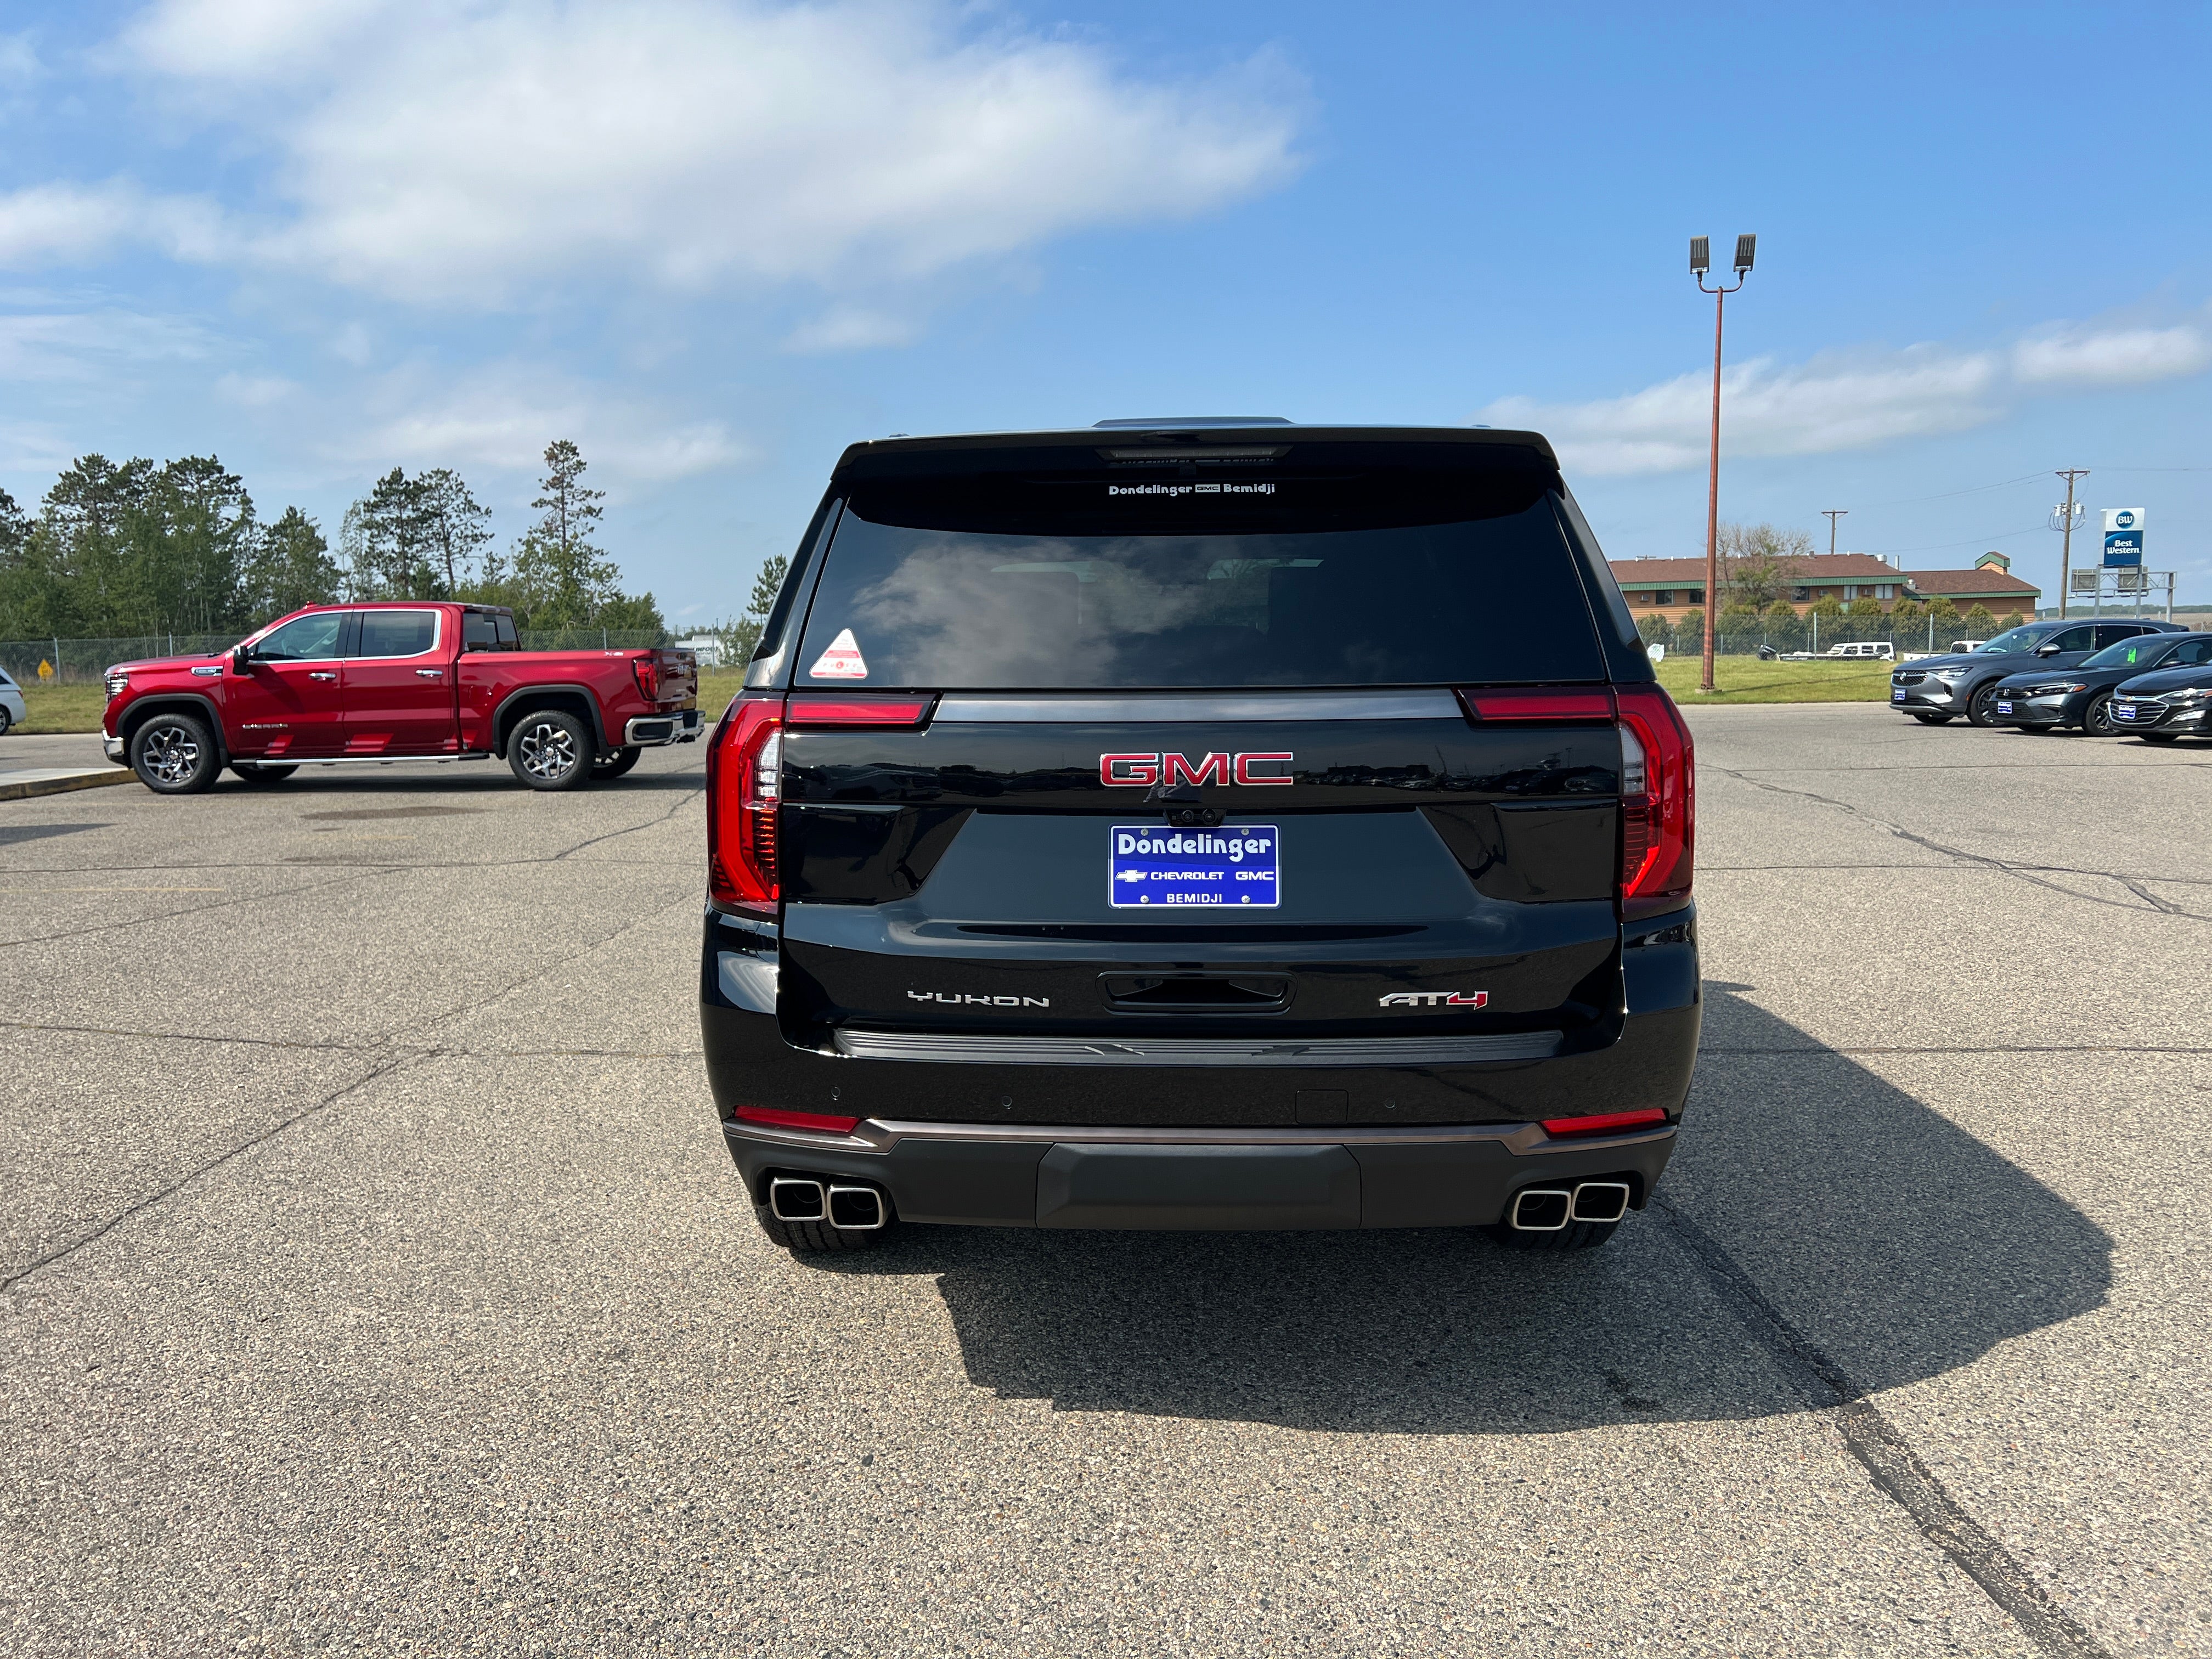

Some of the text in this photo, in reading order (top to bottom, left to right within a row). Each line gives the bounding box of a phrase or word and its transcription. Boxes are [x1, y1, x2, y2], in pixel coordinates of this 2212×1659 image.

[1109, 484, 1193, 496] Dondelinger
[1223, 484, 1276, 494] Bemidji
[2118, 516, 2133, 524] BW
[1100, 752, 1294, 787] GMC
[1118, 833, 1271, 862] Dondelinger
[1150, 871, 1274, 881] CHEVROLET GMC
[1166, 893, 1222, 903] BEMIDJI
[907, 991, 1049, 1007] YUKON
[1379, 991, 1488, 1011] AT4
